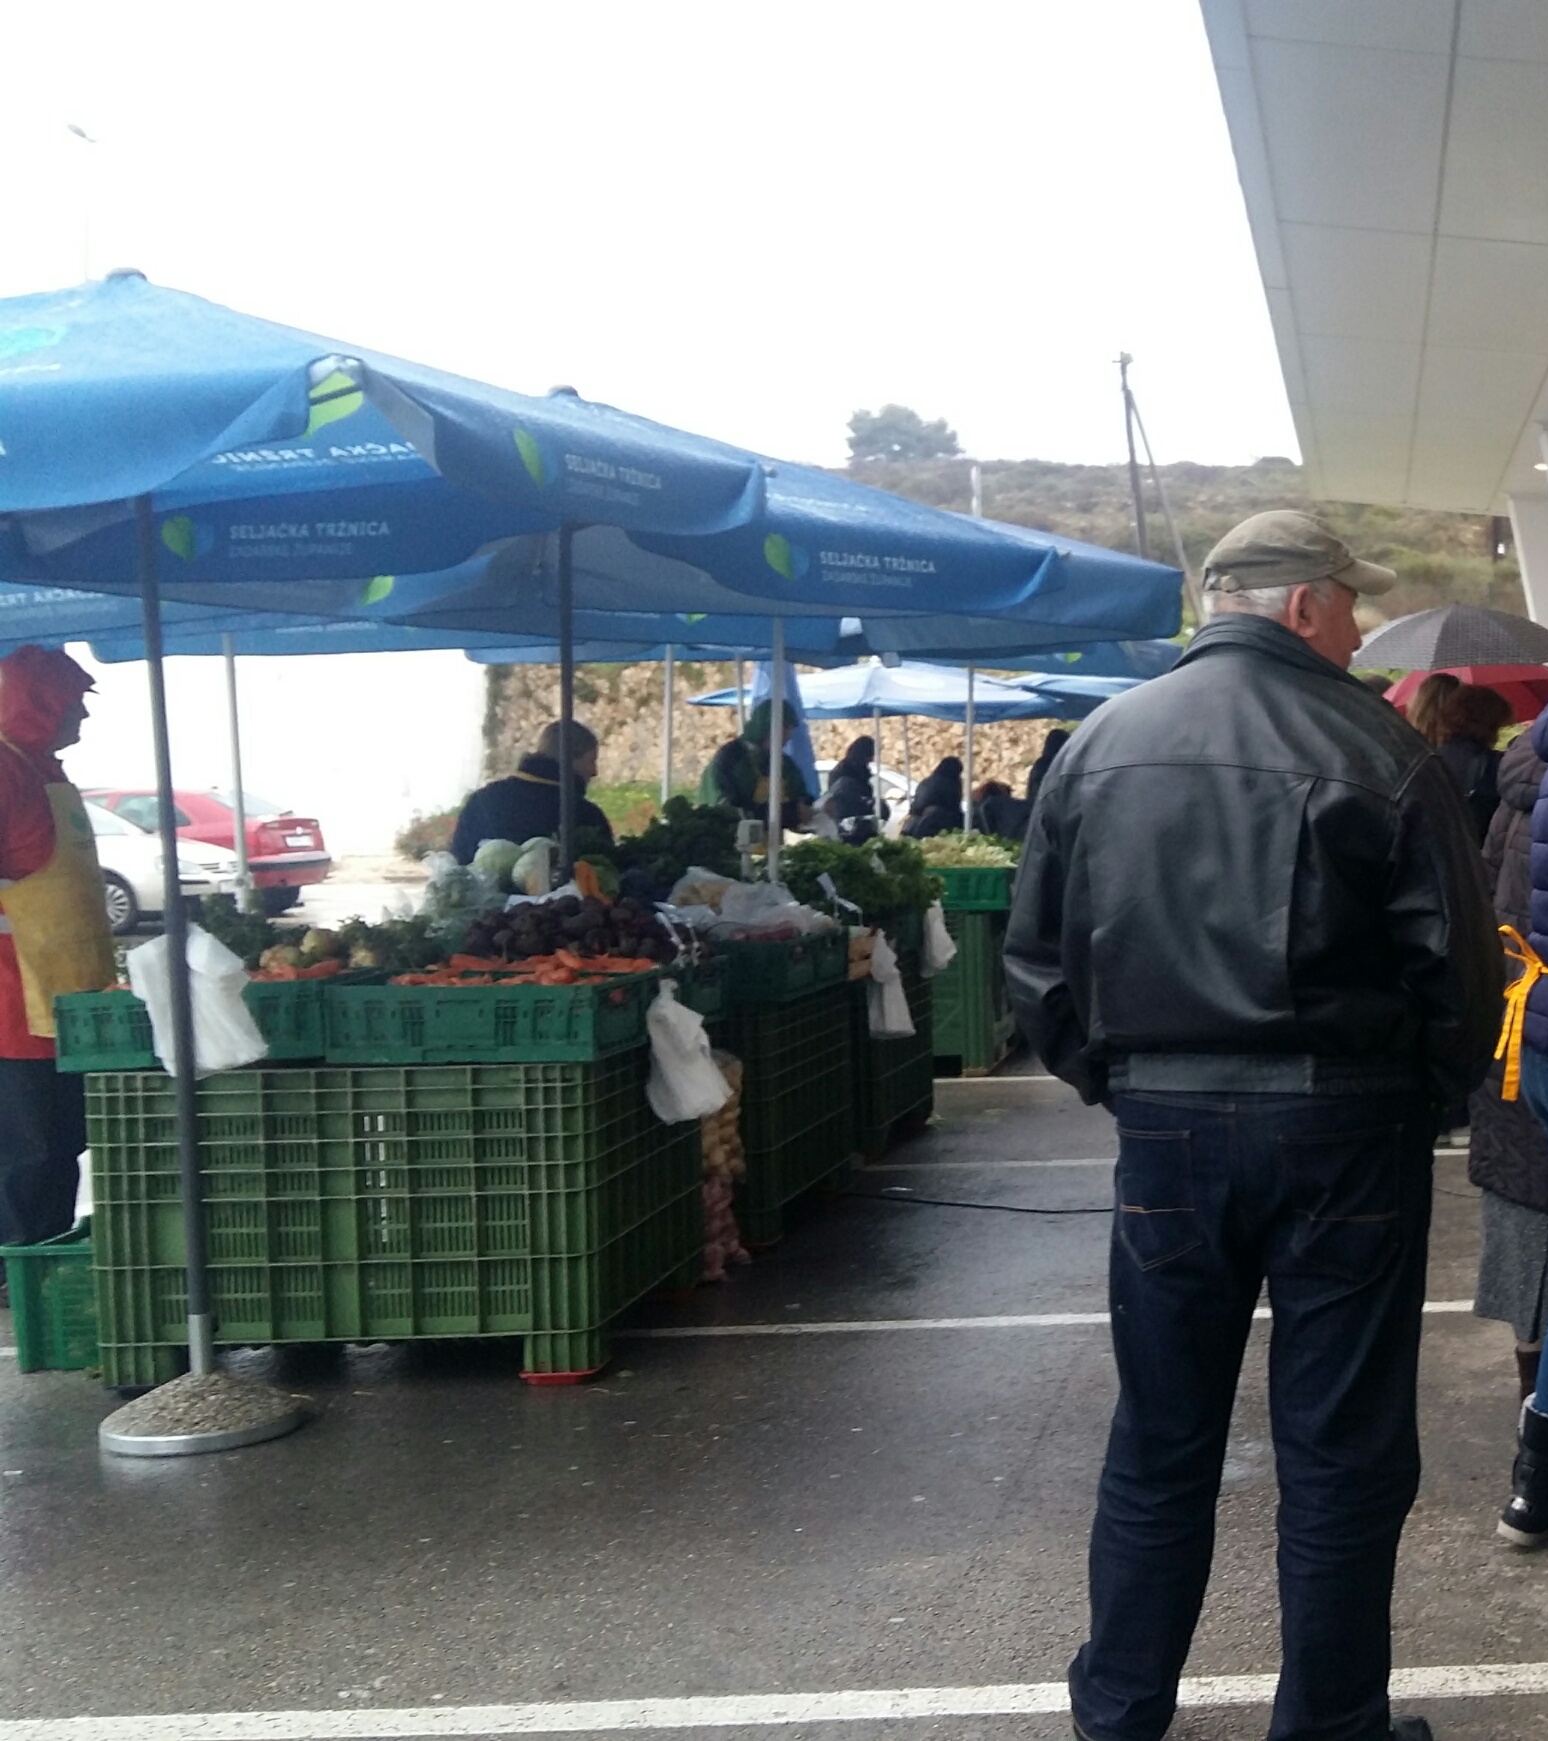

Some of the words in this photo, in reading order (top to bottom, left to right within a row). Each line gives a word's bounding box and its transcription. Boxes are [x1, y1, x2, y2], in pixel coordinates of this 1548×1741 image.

[229, 521, 310, 541] SELJAČKA
[314, 519, 391, 538] TRŽNICA
[819, 550, 881, 570] SELJAČKA
[882, 554, 937, 575] TRŽNICA
